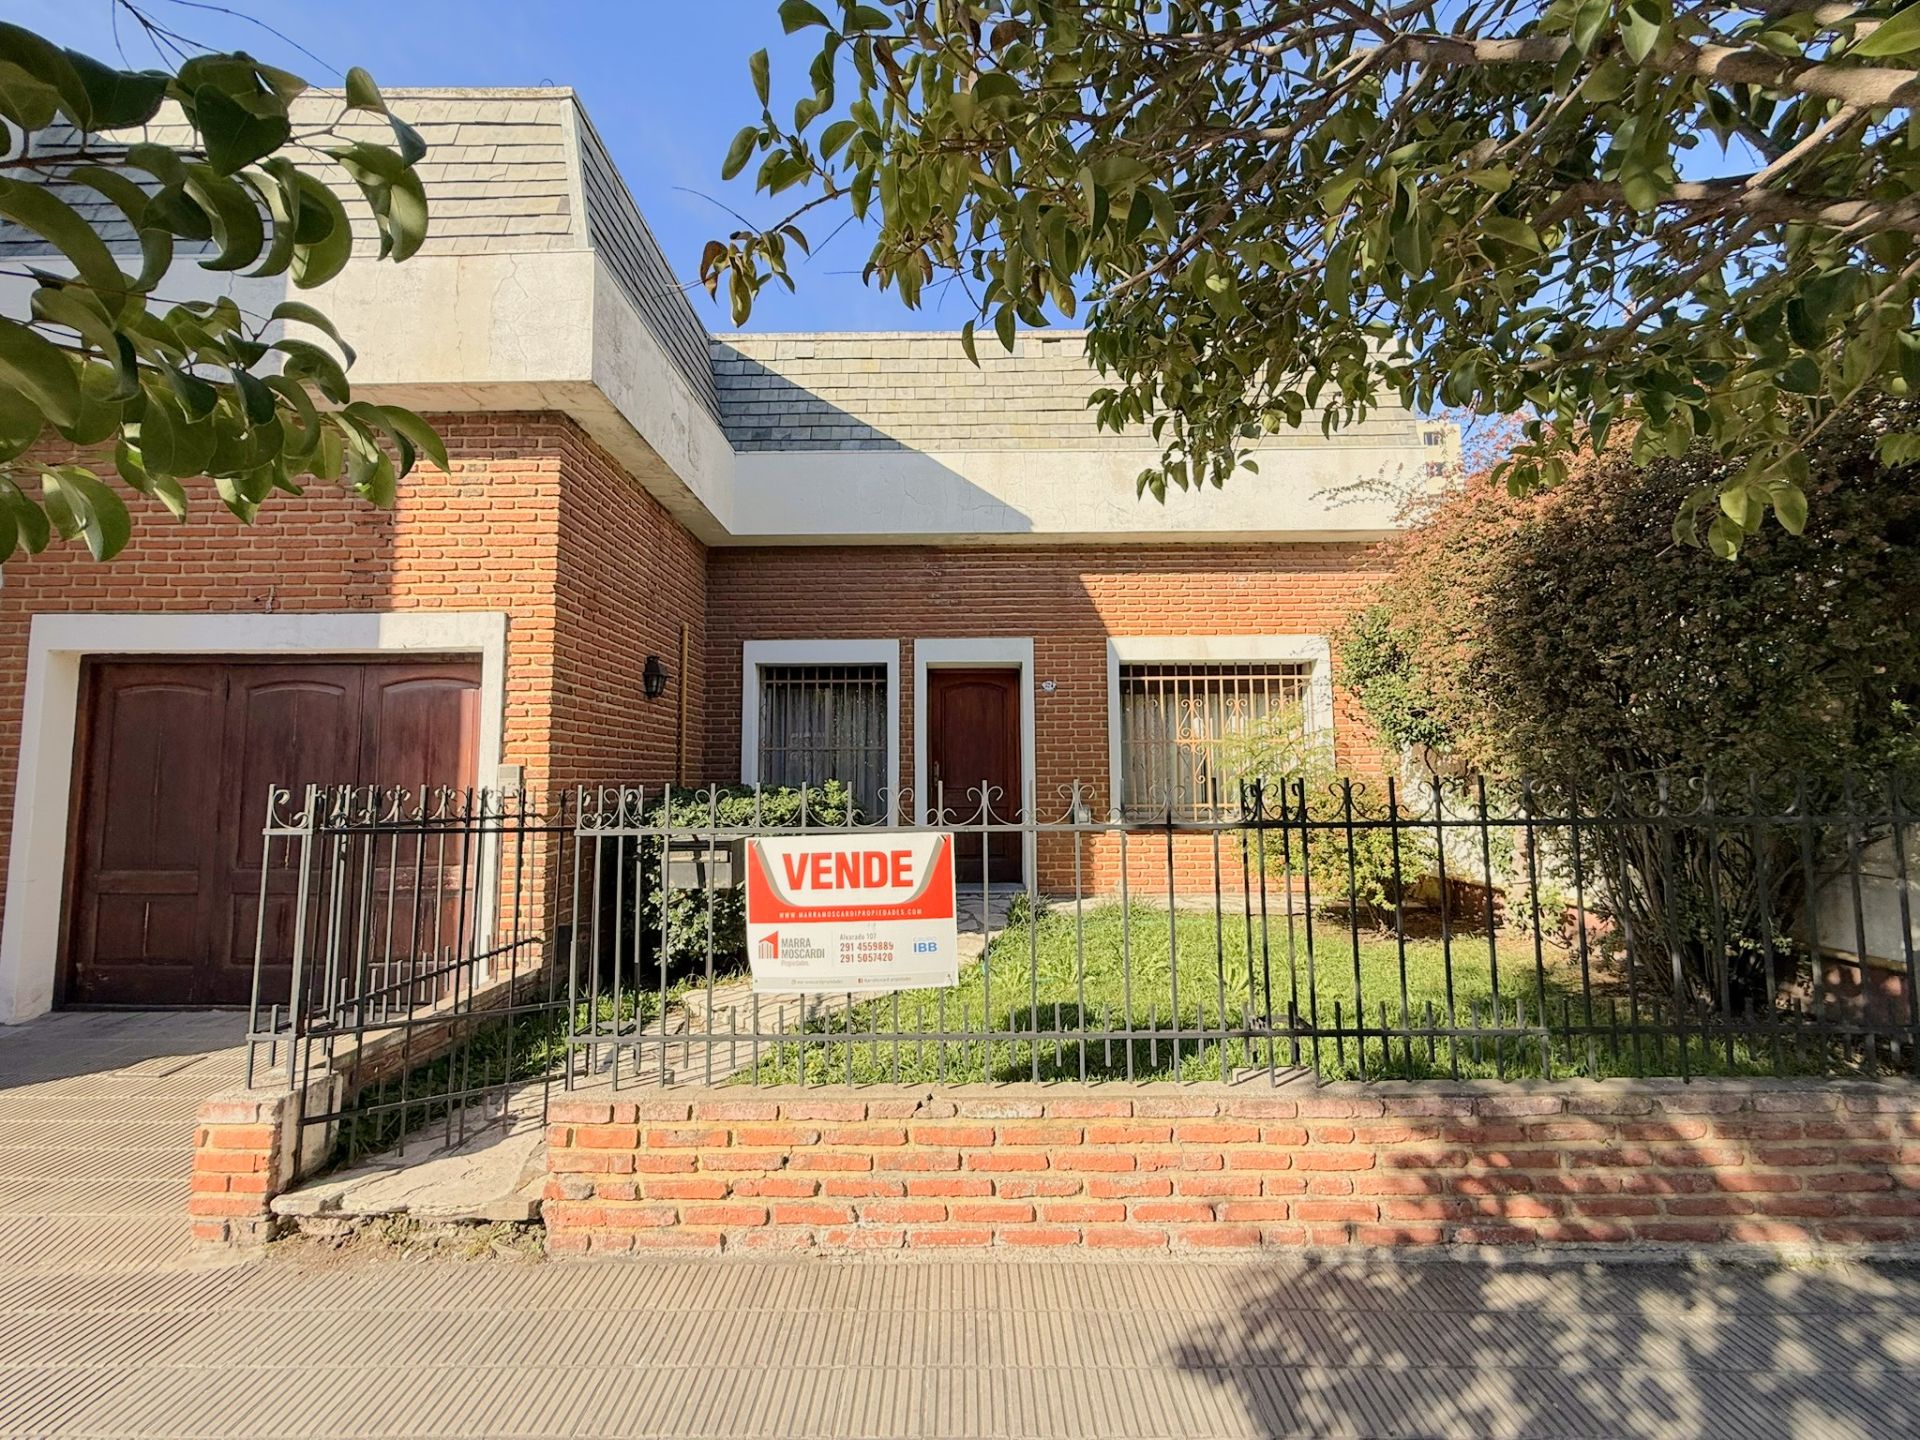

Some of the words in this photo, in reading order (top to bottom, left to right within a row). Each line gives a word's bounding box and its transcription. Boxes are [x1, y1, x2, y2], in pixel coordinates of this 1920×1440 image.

[782, 850, 914, 890] VENDE
[840, 932, 865, 940] Alvarado
[782, 937, 811, 948] MARRA
[840, 942, 854, 952] 291
[914, 942, 938, 953] IBB
[782, 948, 825, 959] MOSCARDI
[840, 953, 854, 963] 291
[857, 952, 894, 963] 5057420
